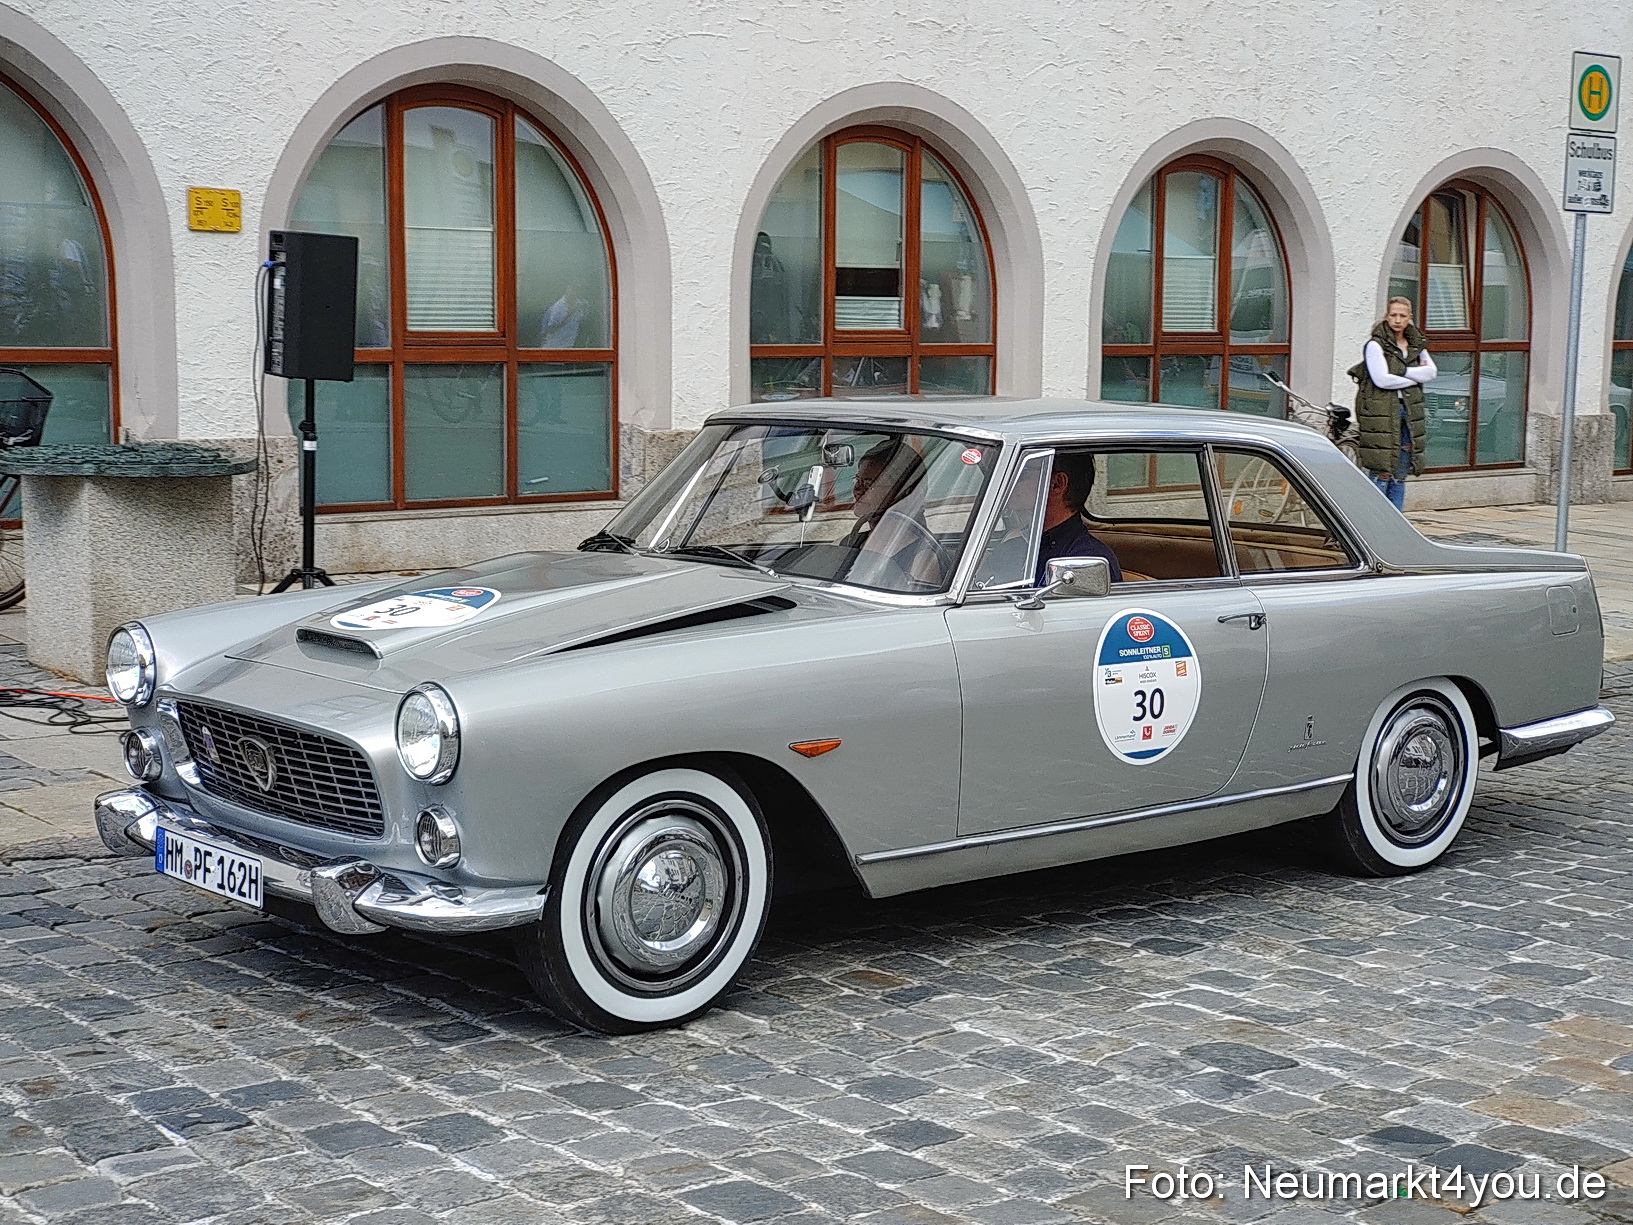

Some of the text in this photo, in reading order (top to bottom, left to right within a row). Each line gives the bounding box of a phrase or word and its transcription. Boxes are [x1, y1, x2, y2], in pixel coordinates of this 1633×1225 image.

[1587, 76, 1603, 109] H
[1568, 141, 1612, 160] Schulbus
[374, 604, 422, 617] 30
[1119, 647, 1161, 656] SONNLEITNER
[1132, 687, 1165, 722] 30
[165, 836, 259, 902] HM PF 162H
